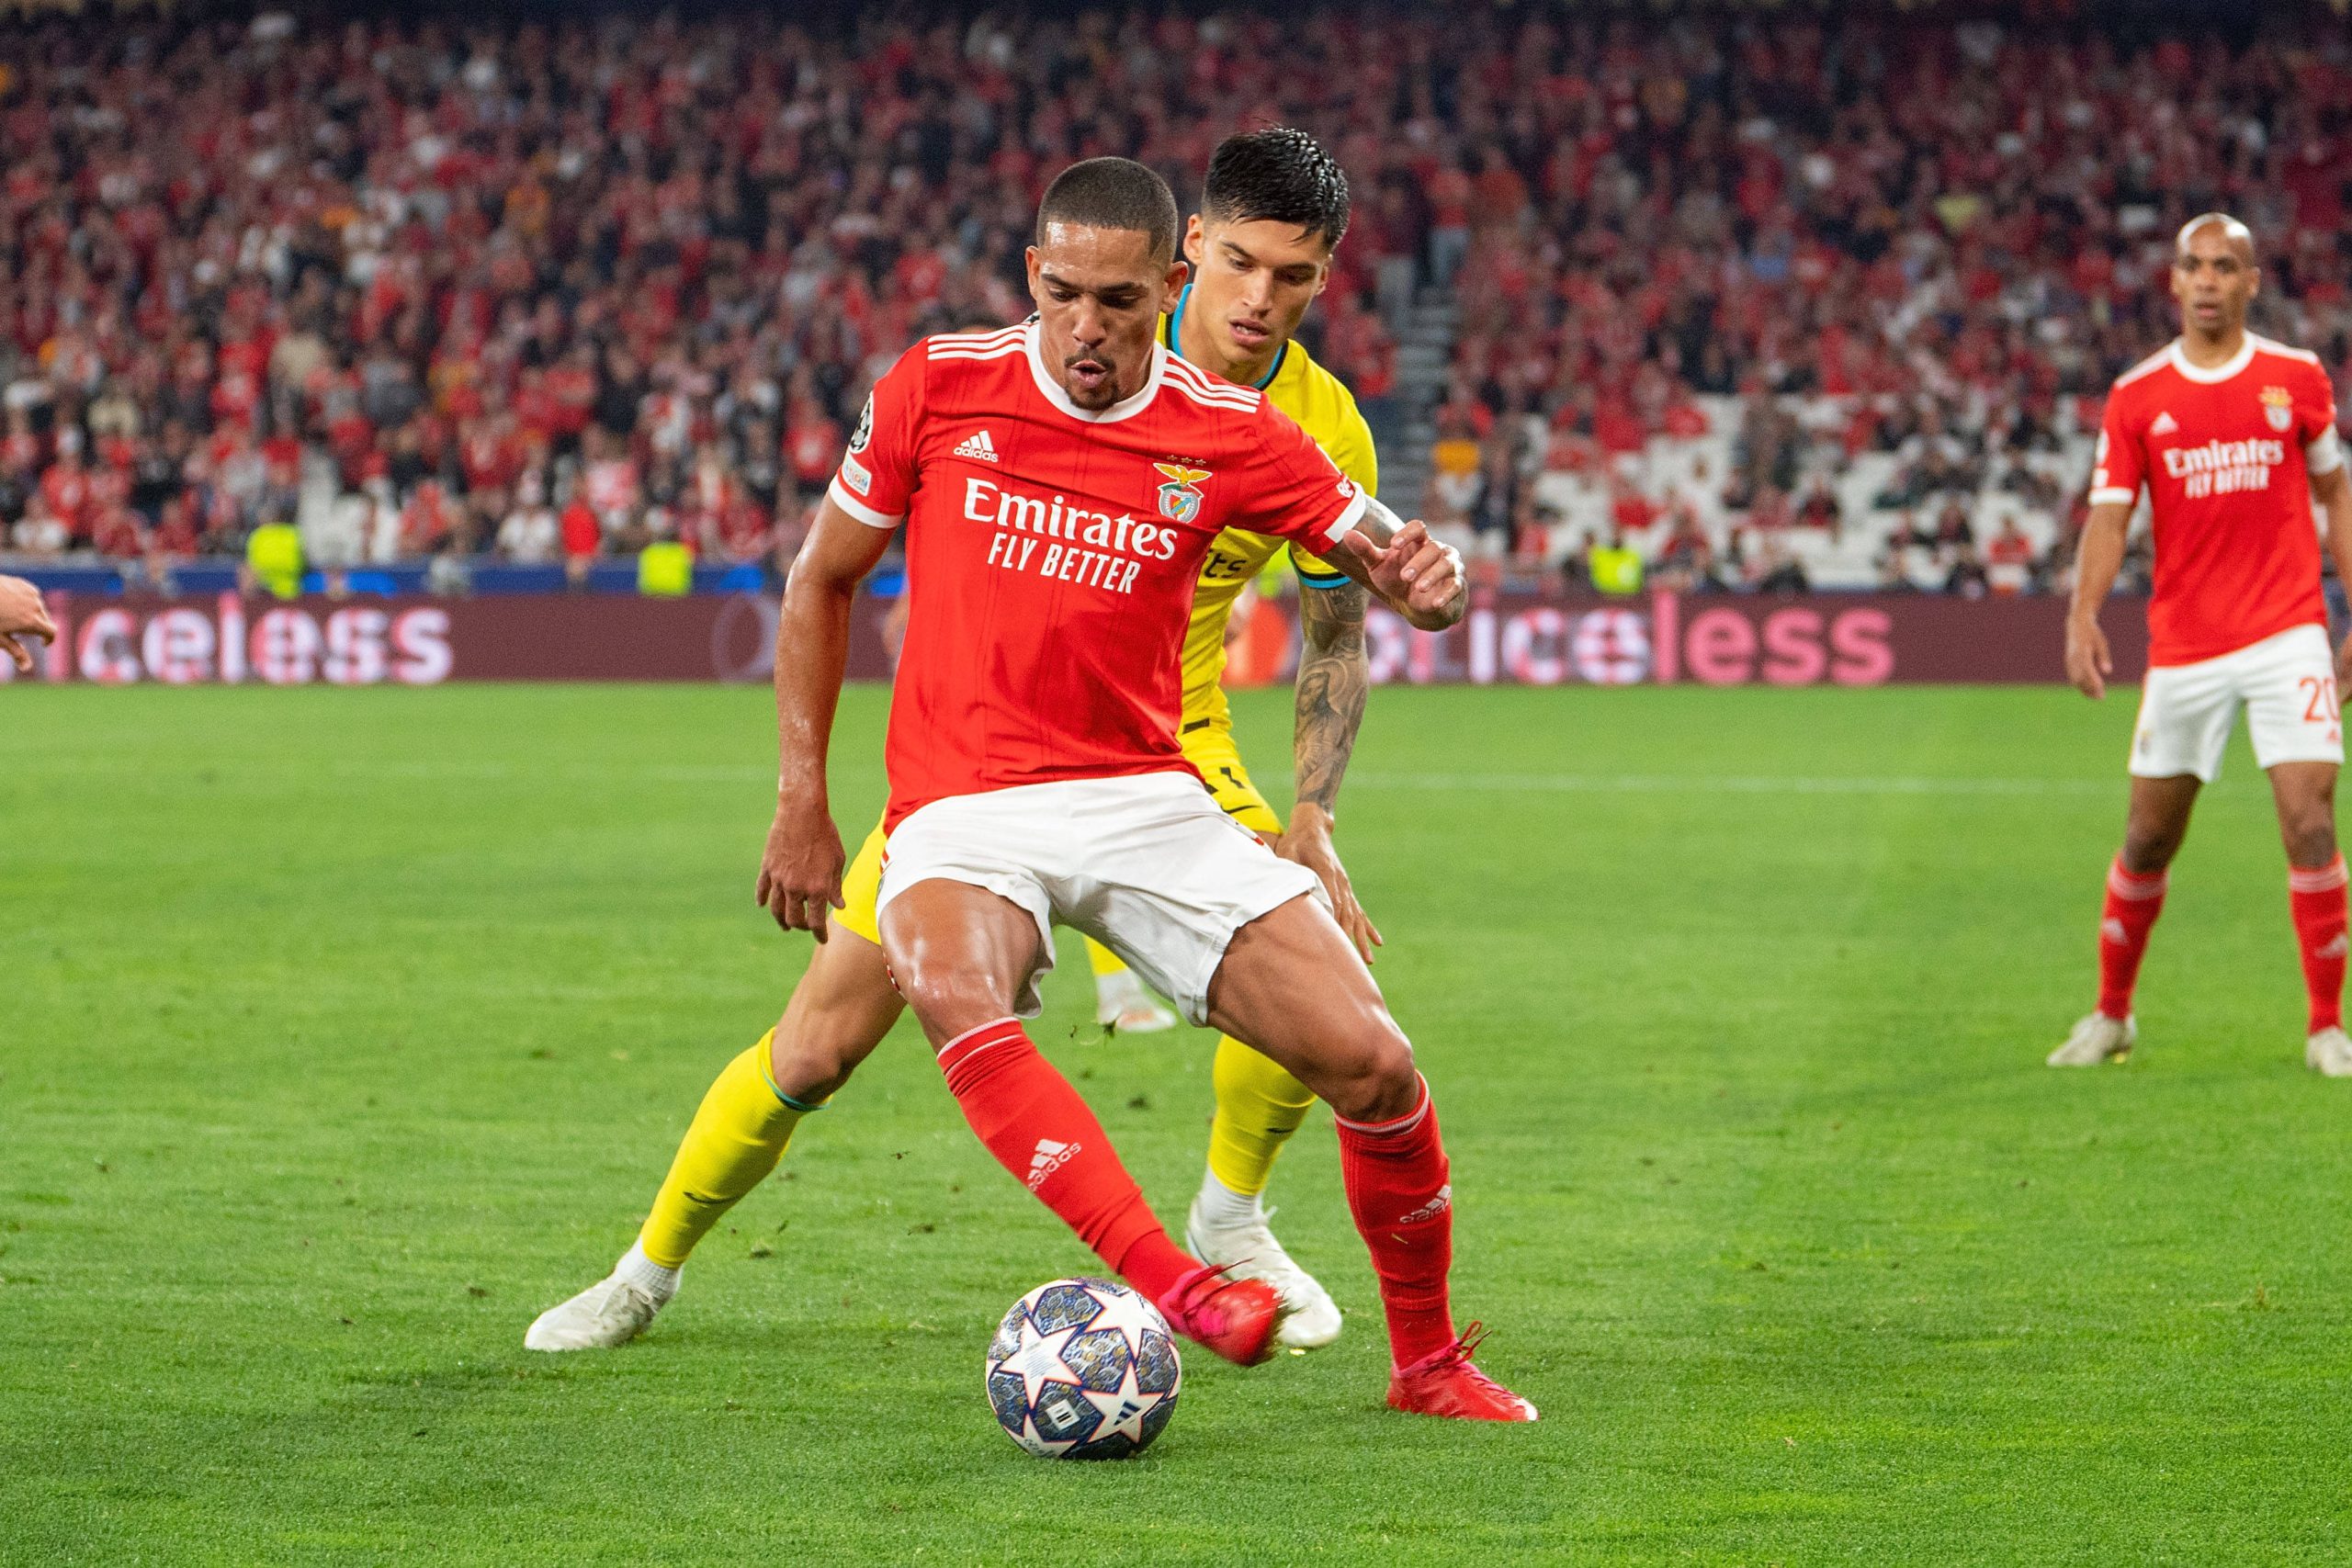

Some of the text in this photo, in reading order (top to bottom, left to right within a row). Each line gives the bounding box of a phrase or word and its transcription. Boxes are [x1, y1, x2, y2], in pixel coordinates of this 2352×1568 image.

[953, 446, 999, 463] adidas
[2163, 437, 2284, 479] Emirates
[965, 477, 1178, 560] Emirates
[987, 532, 1141, 594] FLY BETTER
[1204, 548, 1247, 579] ts
[0, 589, 454, 684] iceless
